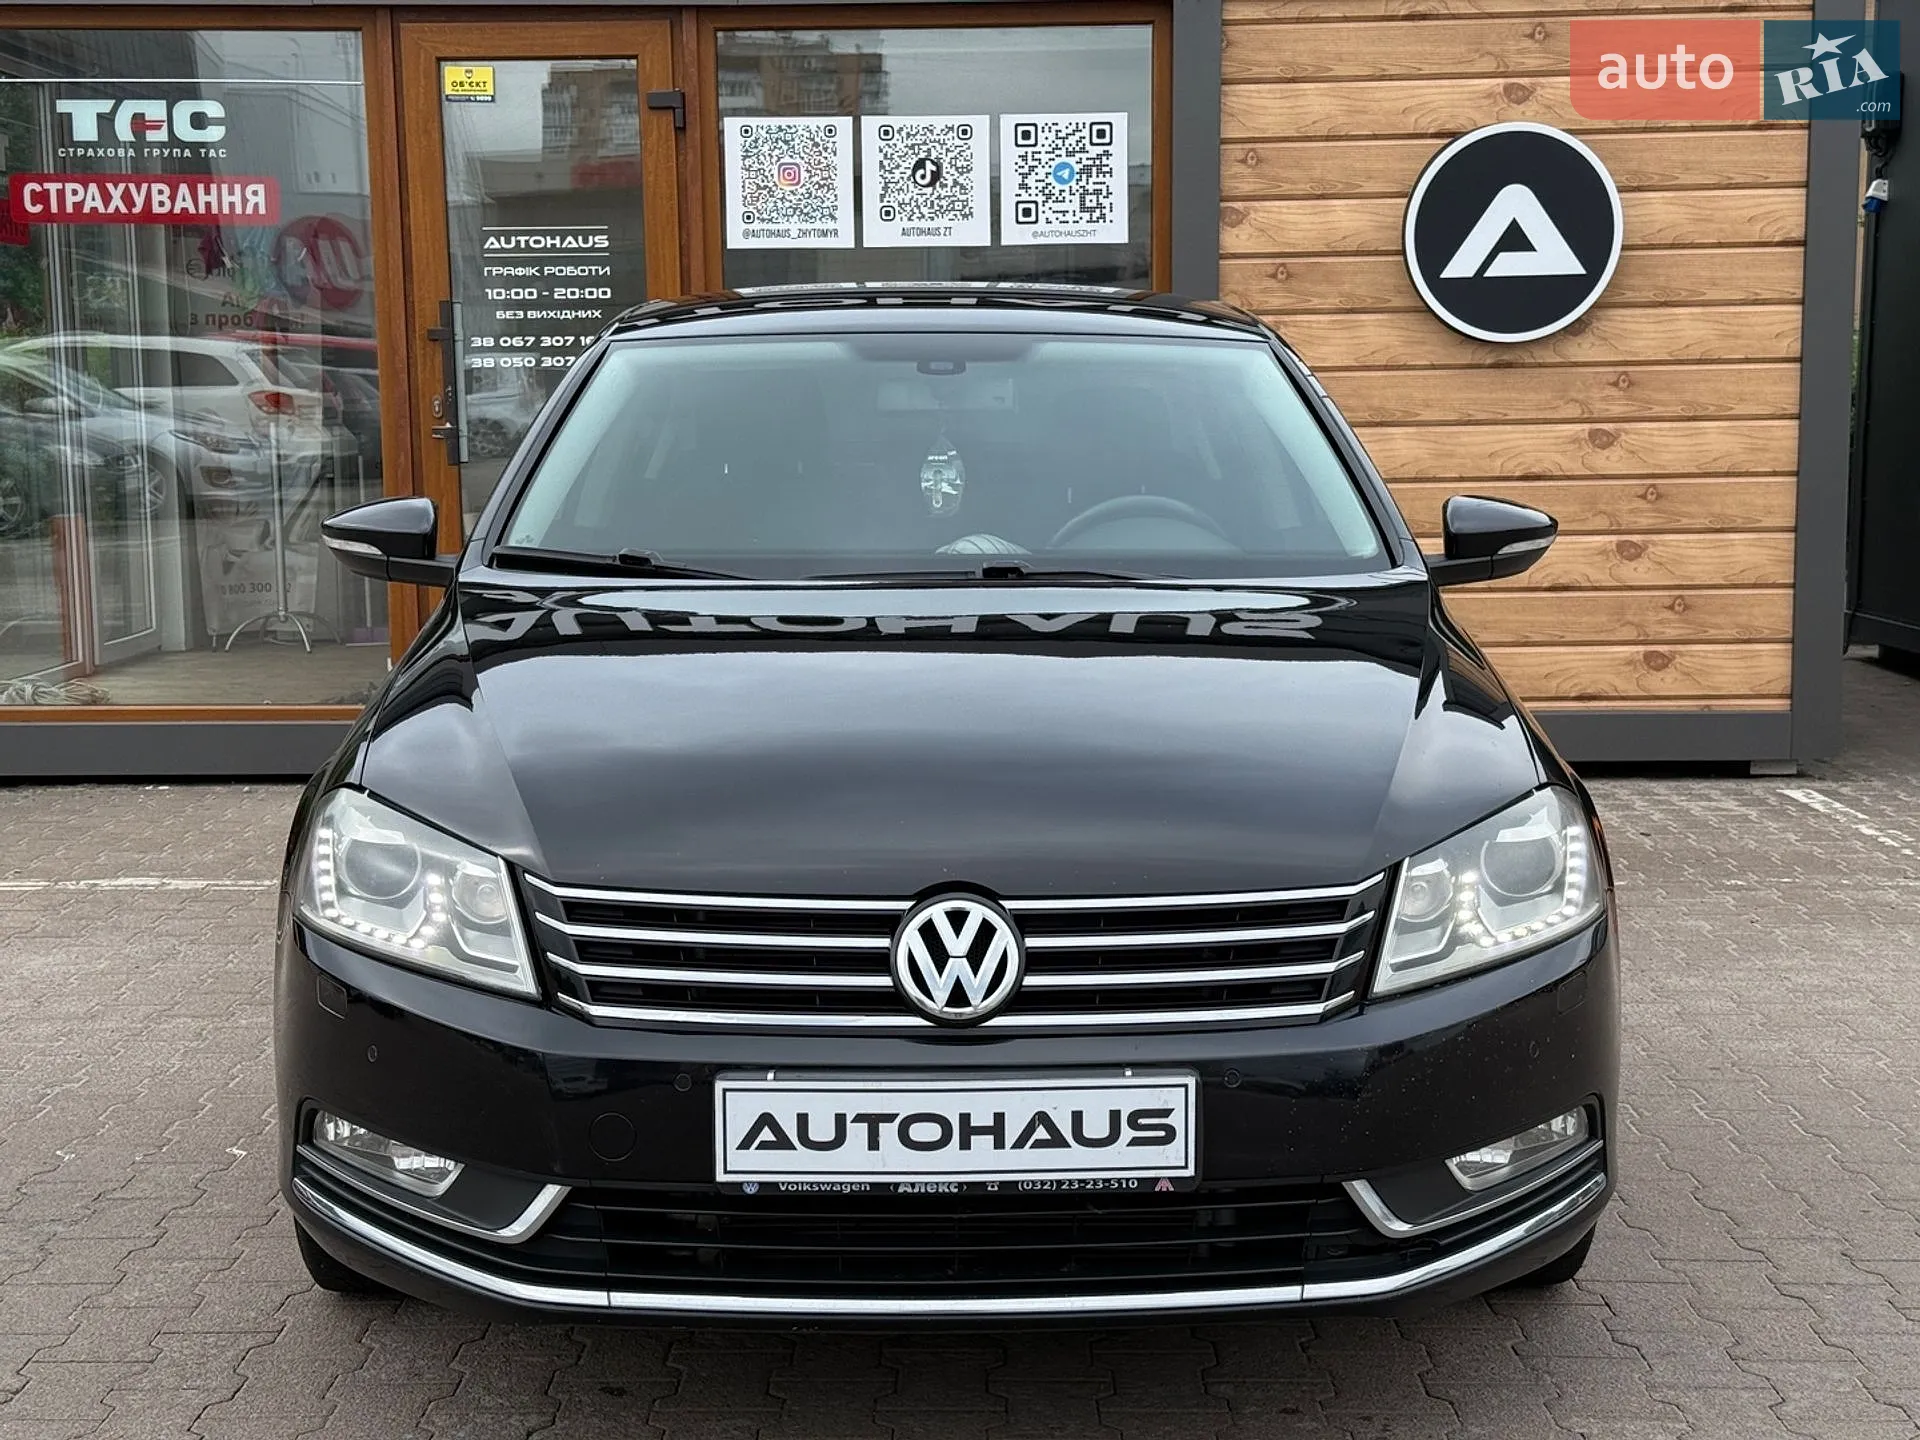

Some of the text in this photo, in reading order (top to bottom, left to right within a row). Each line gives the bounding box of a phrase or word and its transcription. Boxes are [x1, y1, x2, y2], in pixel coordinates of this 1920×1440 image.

[58, 148, 228, 158] СТРАХОВА ГРУПА ТАС
[23, 182, 267, 215] СТРАХУВАННЯ
[742, 228, 839, 239] @AUTOHAUS_ZHYTOMYR
[901, 227, 952, 237] AUTOHAUS ZT
[483, 235, 610, 249] AUTOHAUS
[484, 266, 611, 276] ГРАФІК РОБОТИ
[485, 288, 538, 300] 10:00
[554, 288, 612, 299] 20:00
[496, 310, 602, 319] БЕЗ ВИХІДНИХ
[470, 337, 495, 347] 38
[499, 337, 536, 347] 067
[540, 336, 575, 347] 307
[471, 356, 576, 368] 38 050 307
[735, 1107, 1178, 1152] AUTOHAUS
[778, 1182, 871, 1193] Volkswagen
[1018, 1178, 1138, 1191] (032) 23-23-510
